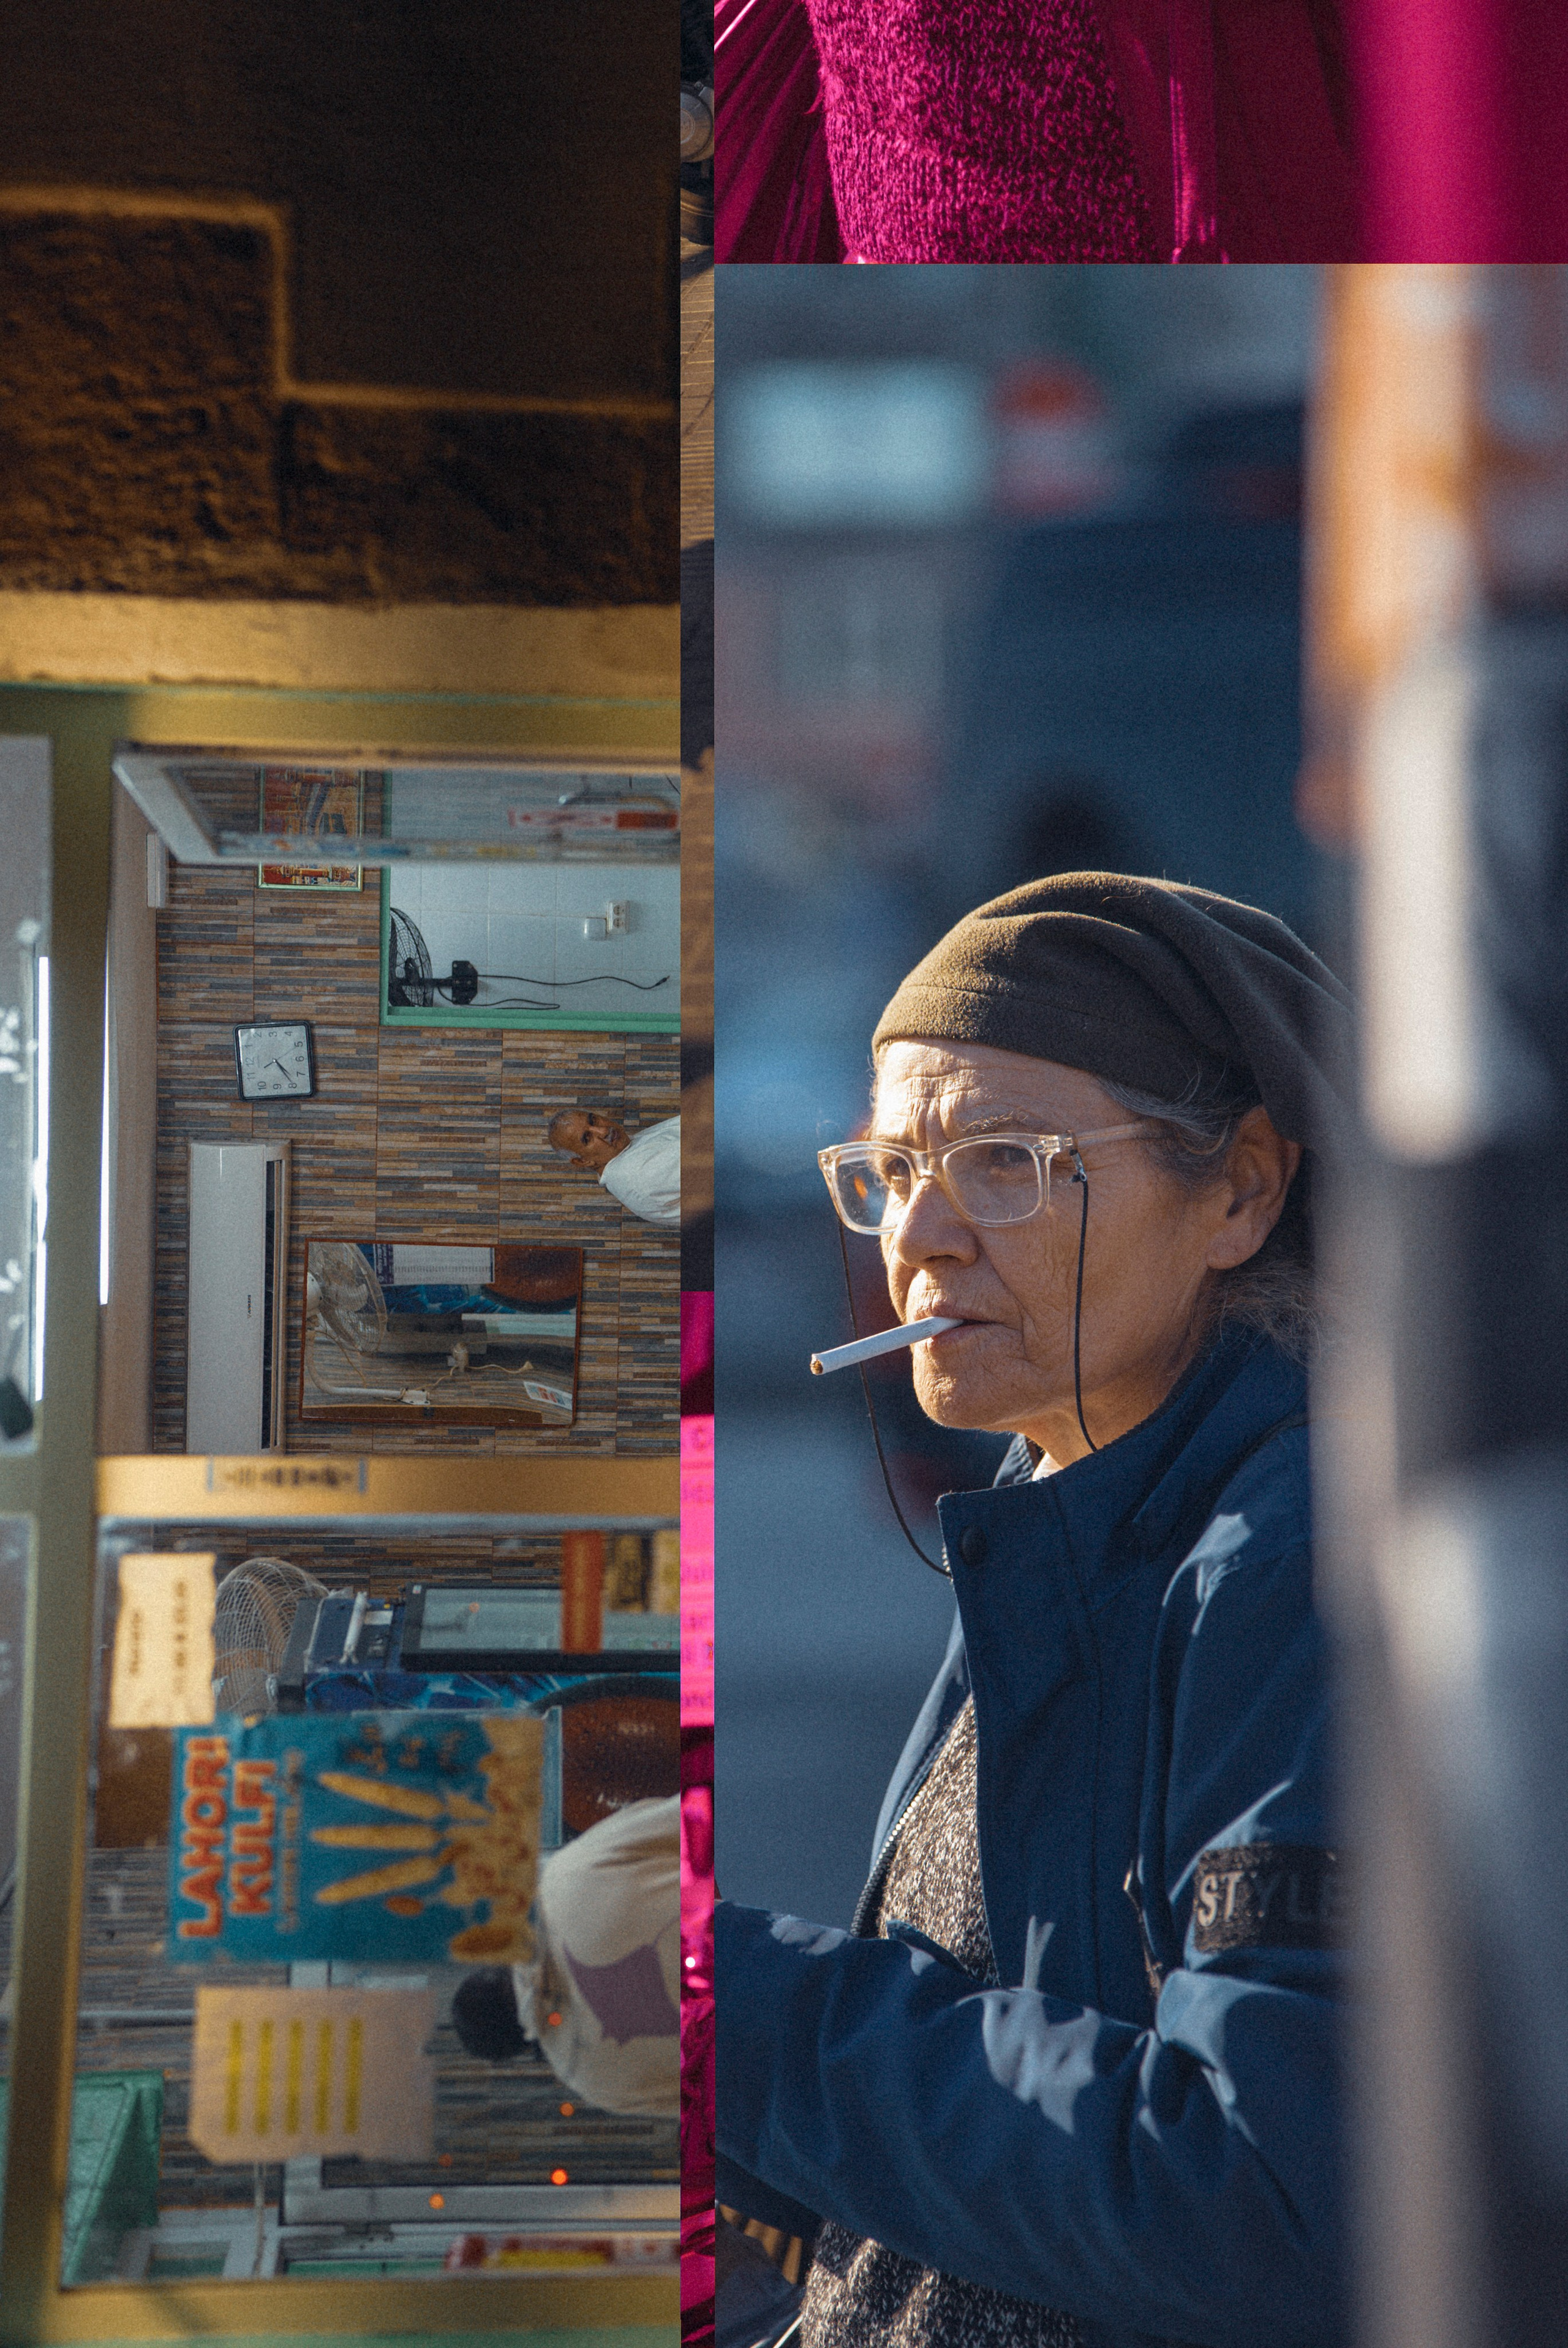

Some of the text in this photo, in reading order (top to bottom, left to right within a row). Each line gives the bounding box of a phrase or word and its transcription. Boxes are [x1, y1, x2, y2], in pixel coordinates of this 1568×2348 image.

[245, 1057, 254, 1067] 12
[247, 1072, 255, 1081] 11
[257, 1081, 266, 1090] 10
[179, 1737, 228, 1938] LAHORI
[228, 1761, 277, 1914] KULFI
